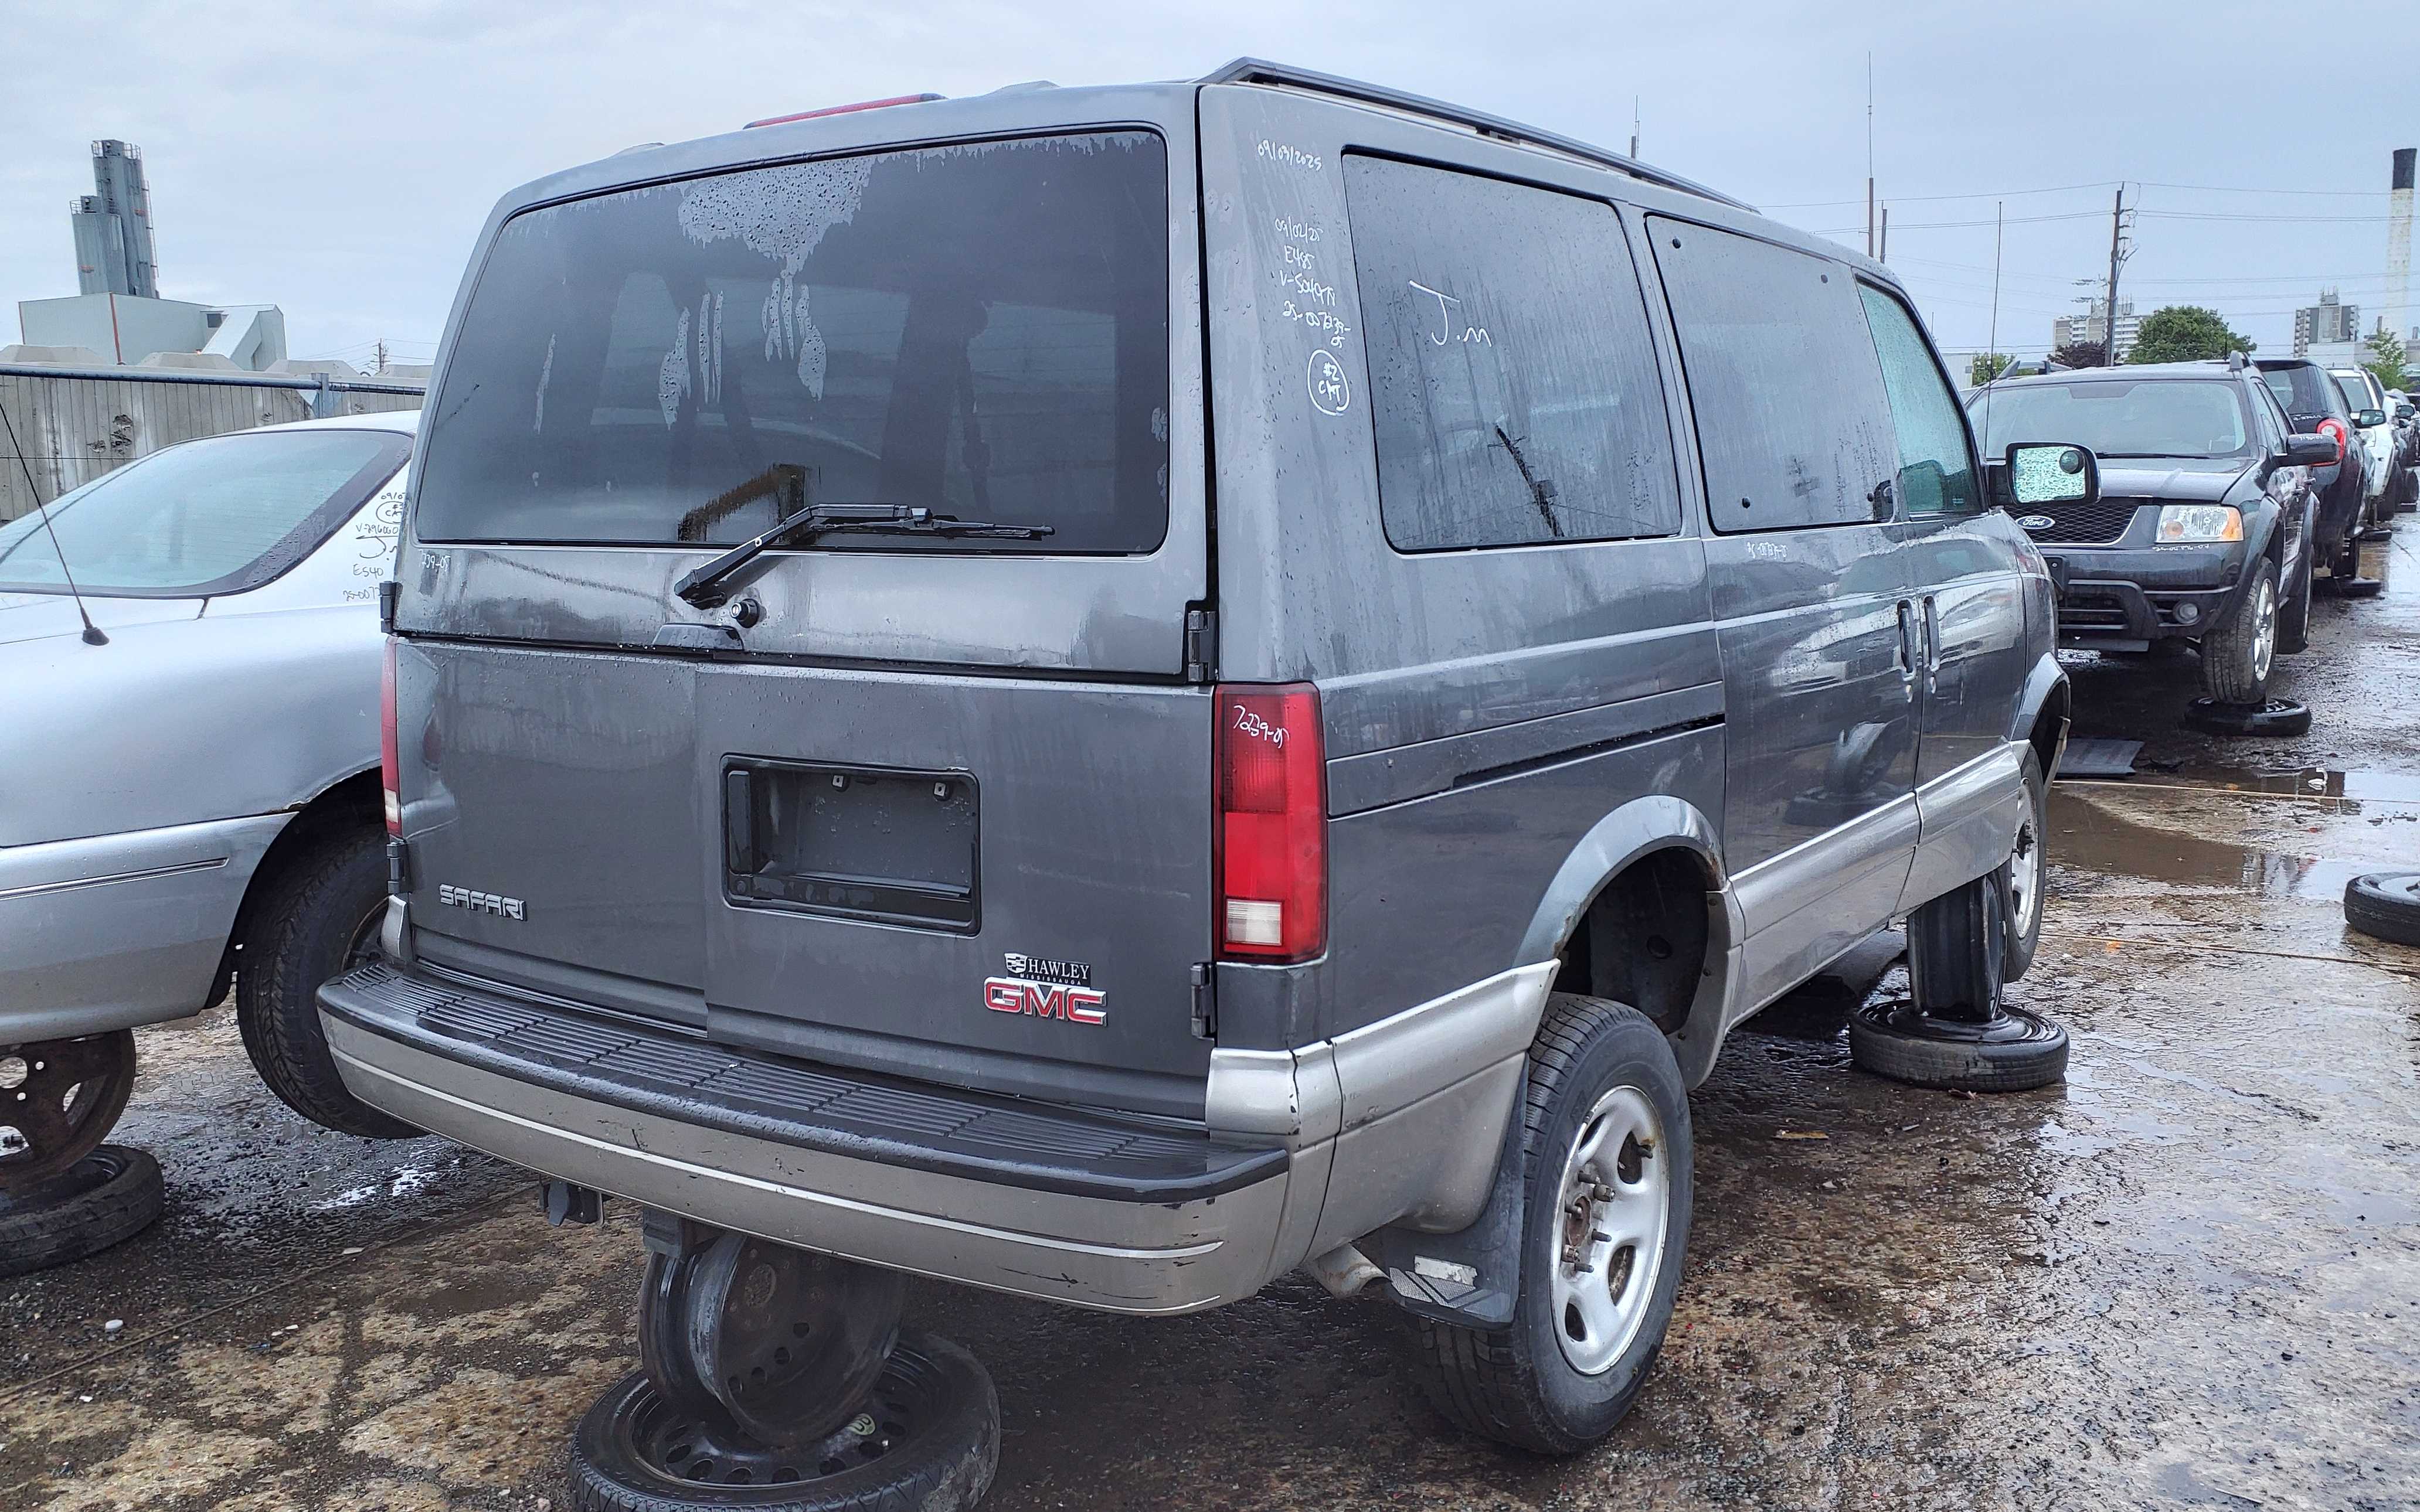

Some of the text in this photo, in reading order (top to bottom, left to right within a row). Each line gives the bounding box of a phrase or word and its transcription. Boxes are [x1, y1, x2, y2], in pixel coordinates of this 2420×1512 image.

[440, 883, 526, 921] SAFARI
[1019, 973, 1082, 986] MISSISSAUGA
[1028, 958, 1090, 980] HAWLEY
[984, 976, 1107, 1027] GMC
